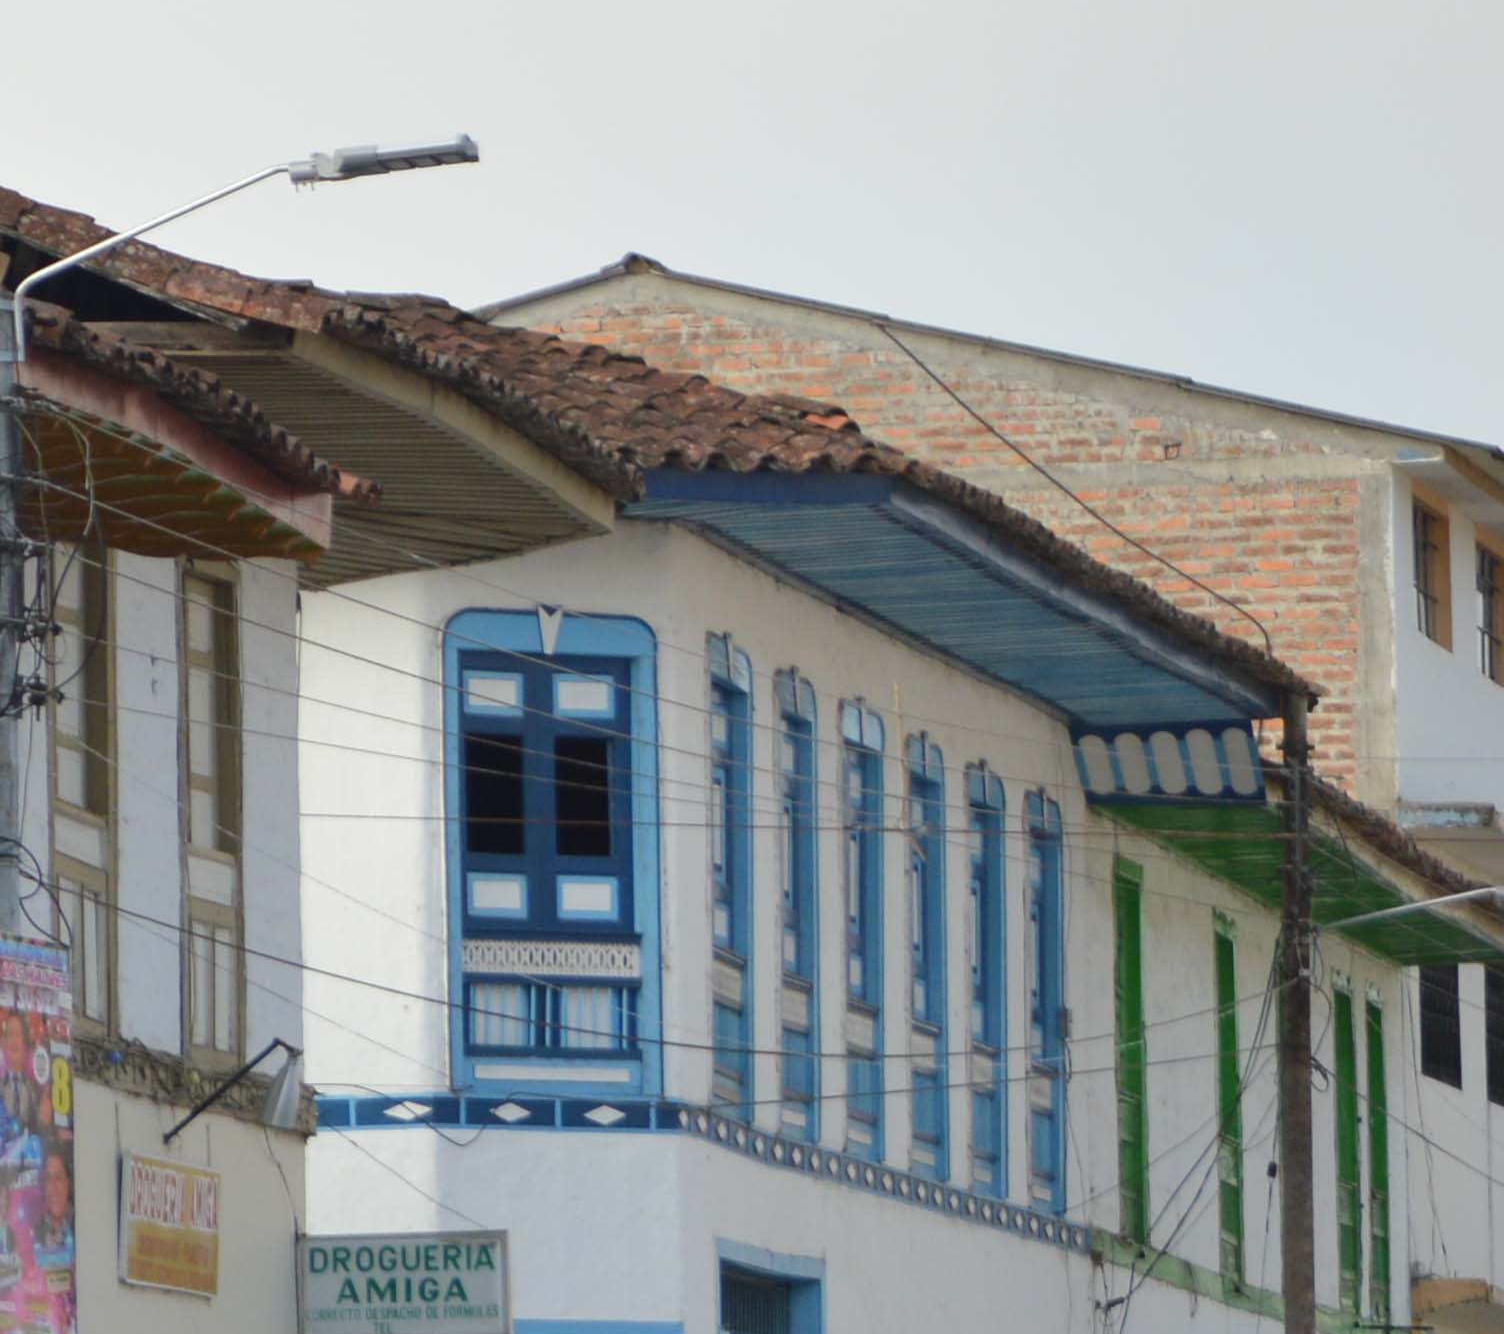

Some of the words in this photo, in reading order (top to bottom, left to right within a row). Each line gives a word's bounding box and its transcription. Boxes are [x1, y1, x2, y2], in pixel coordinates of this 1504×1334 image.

[51, 1056, 70, 1115] 8
[308, 1241, 496, 1273] DROGUERIA
[337, 1276, 468, 1304] AMIGA
[365, 1306, 422, 1321] DESPACHO
[426, 1306, 438, 1319] DE
